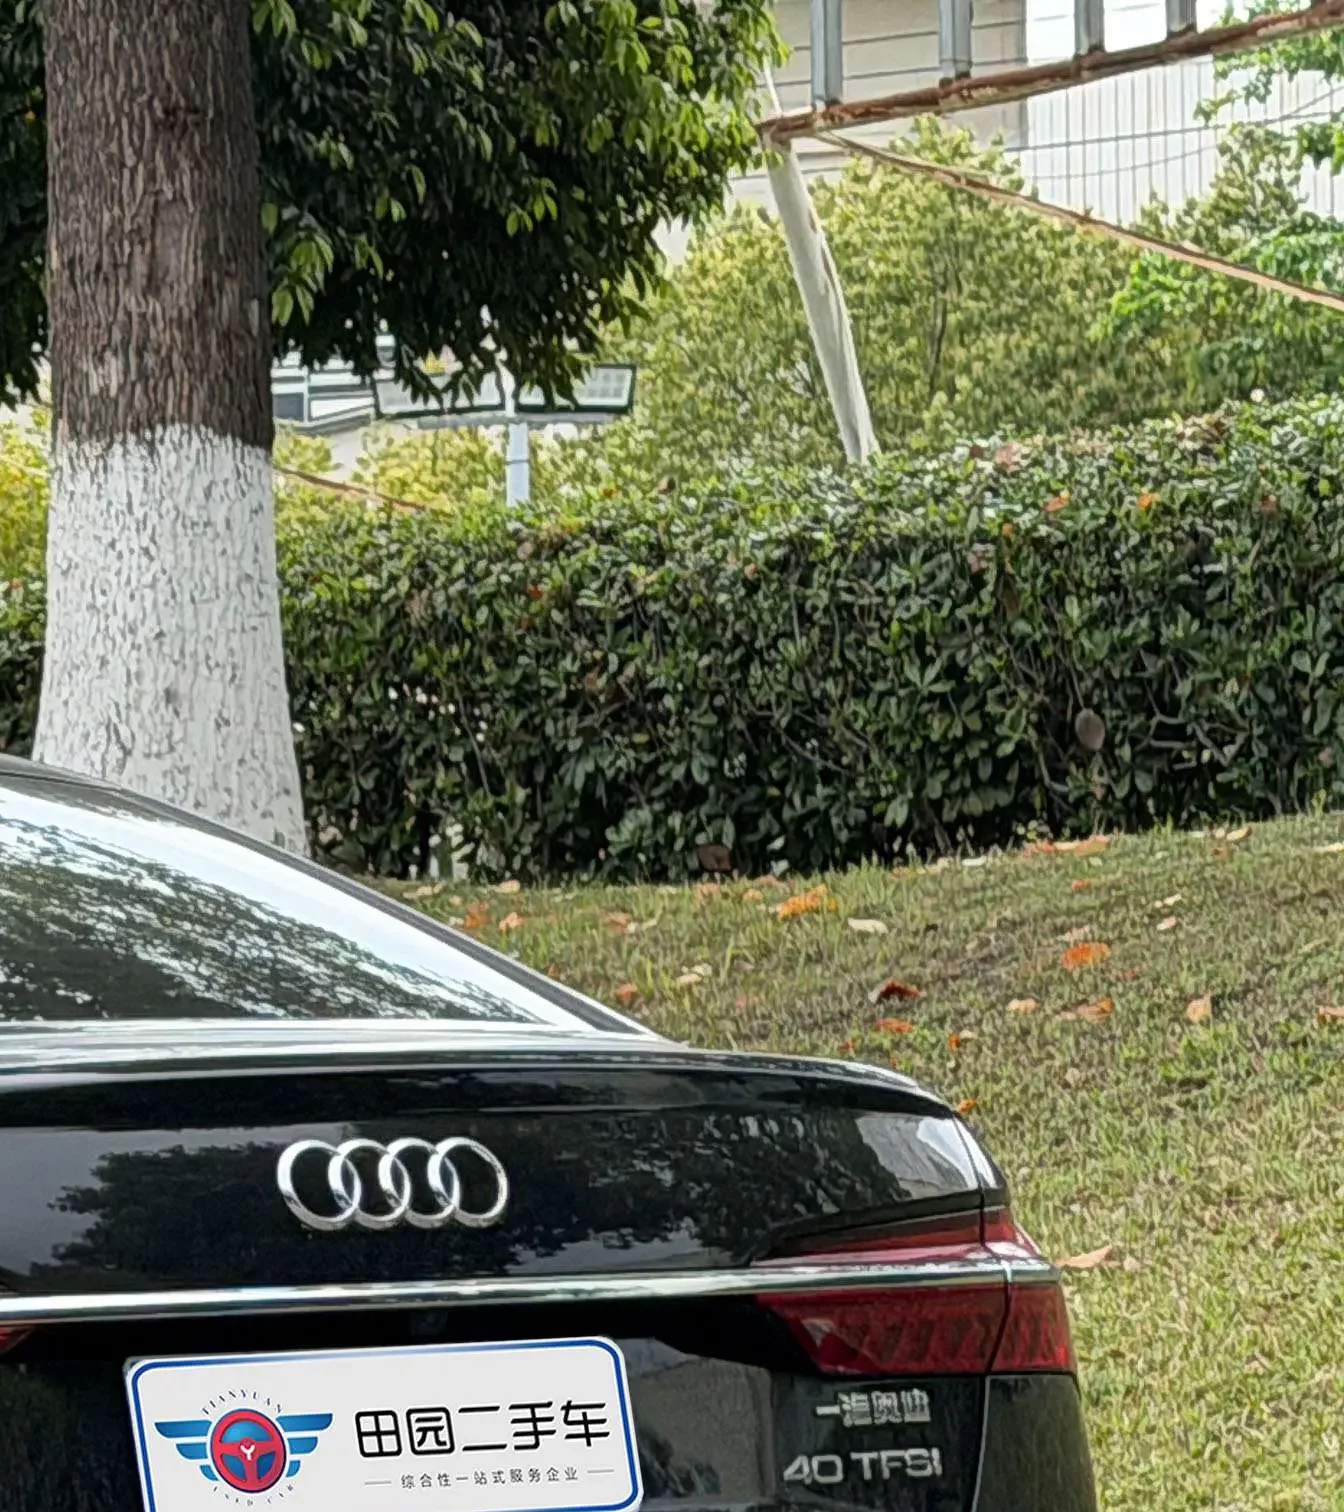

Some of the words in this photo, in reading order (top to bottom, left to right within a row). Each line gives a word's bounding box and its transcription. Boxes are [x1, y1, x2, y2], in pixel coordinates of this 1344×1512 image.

[354, 1399, 611, 1458] 田园二手车
[400, 1466, 579, 1490] 综合性一站式服务企业
[783, 1453, 844, 1485] 40
[850, 1447, 943, 1480] TFSI
